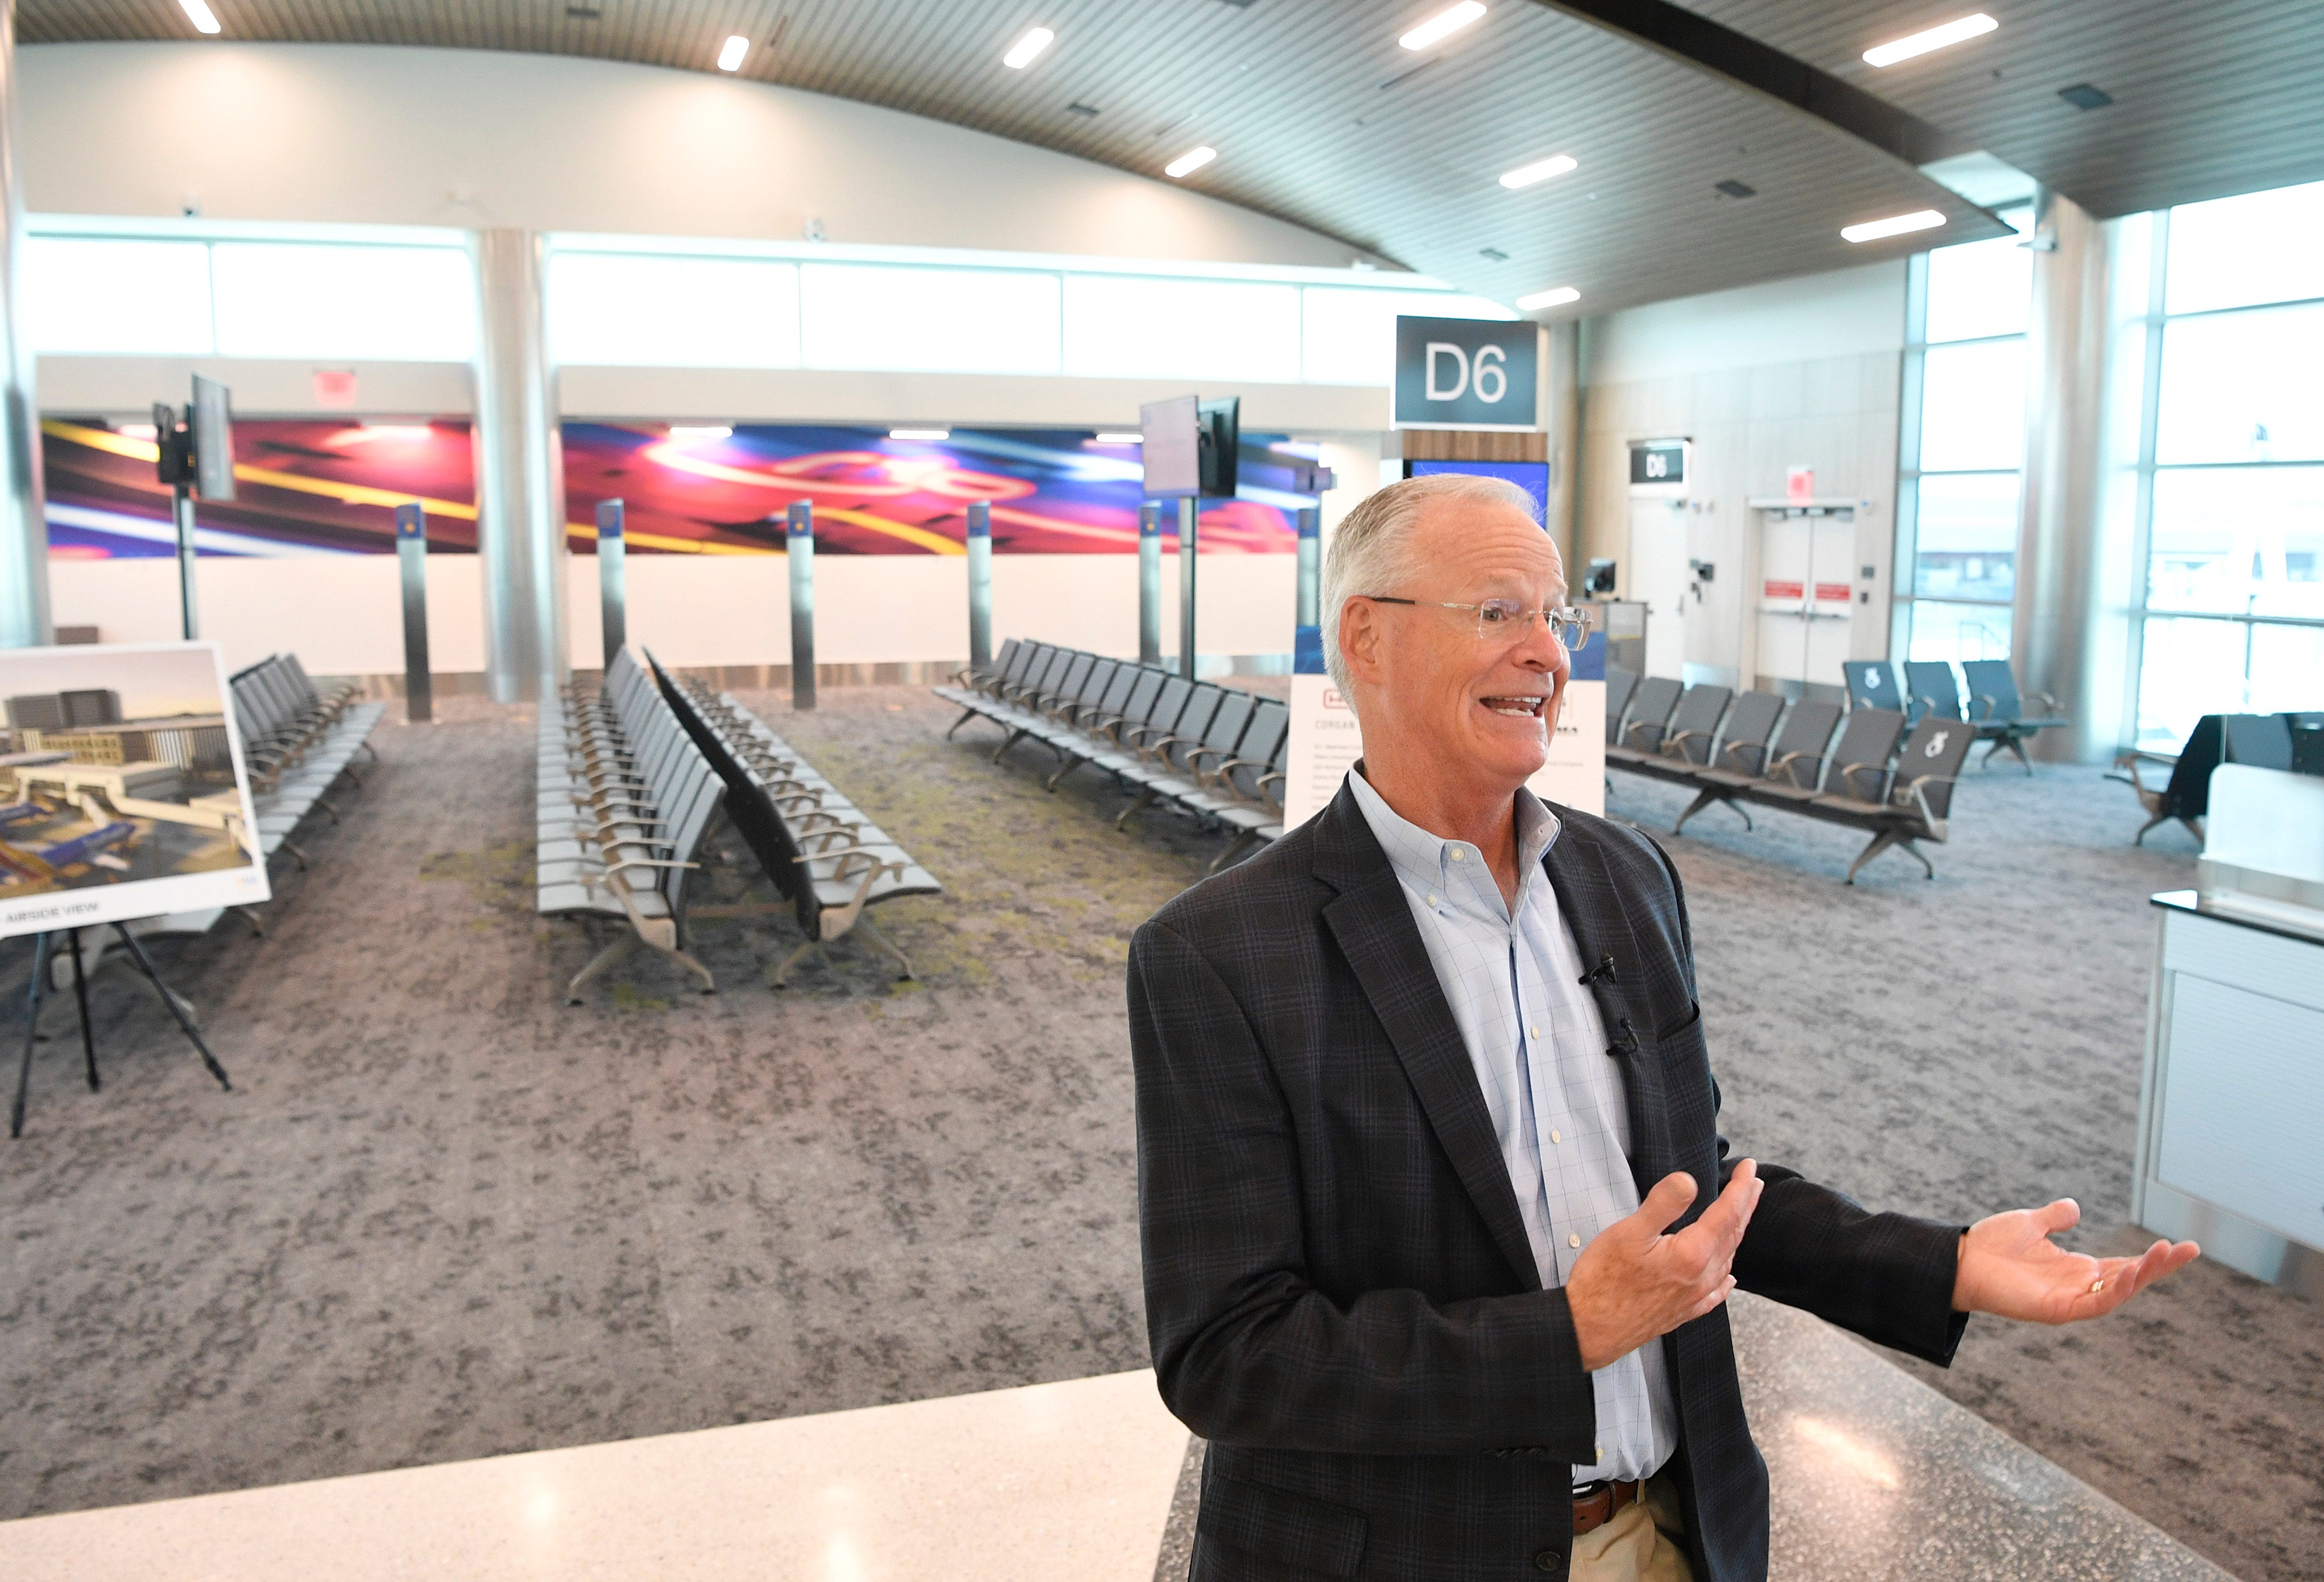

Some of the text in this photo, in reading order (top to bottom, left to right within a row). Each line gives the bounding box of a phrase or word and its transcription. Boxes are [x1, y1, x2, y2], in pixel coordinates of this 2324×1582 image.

[1426, 342, 1507, 403] D6
[1646, 453, 1667, 477] D6
[6, 901, 99, 923] AIRSIDE VIEW
